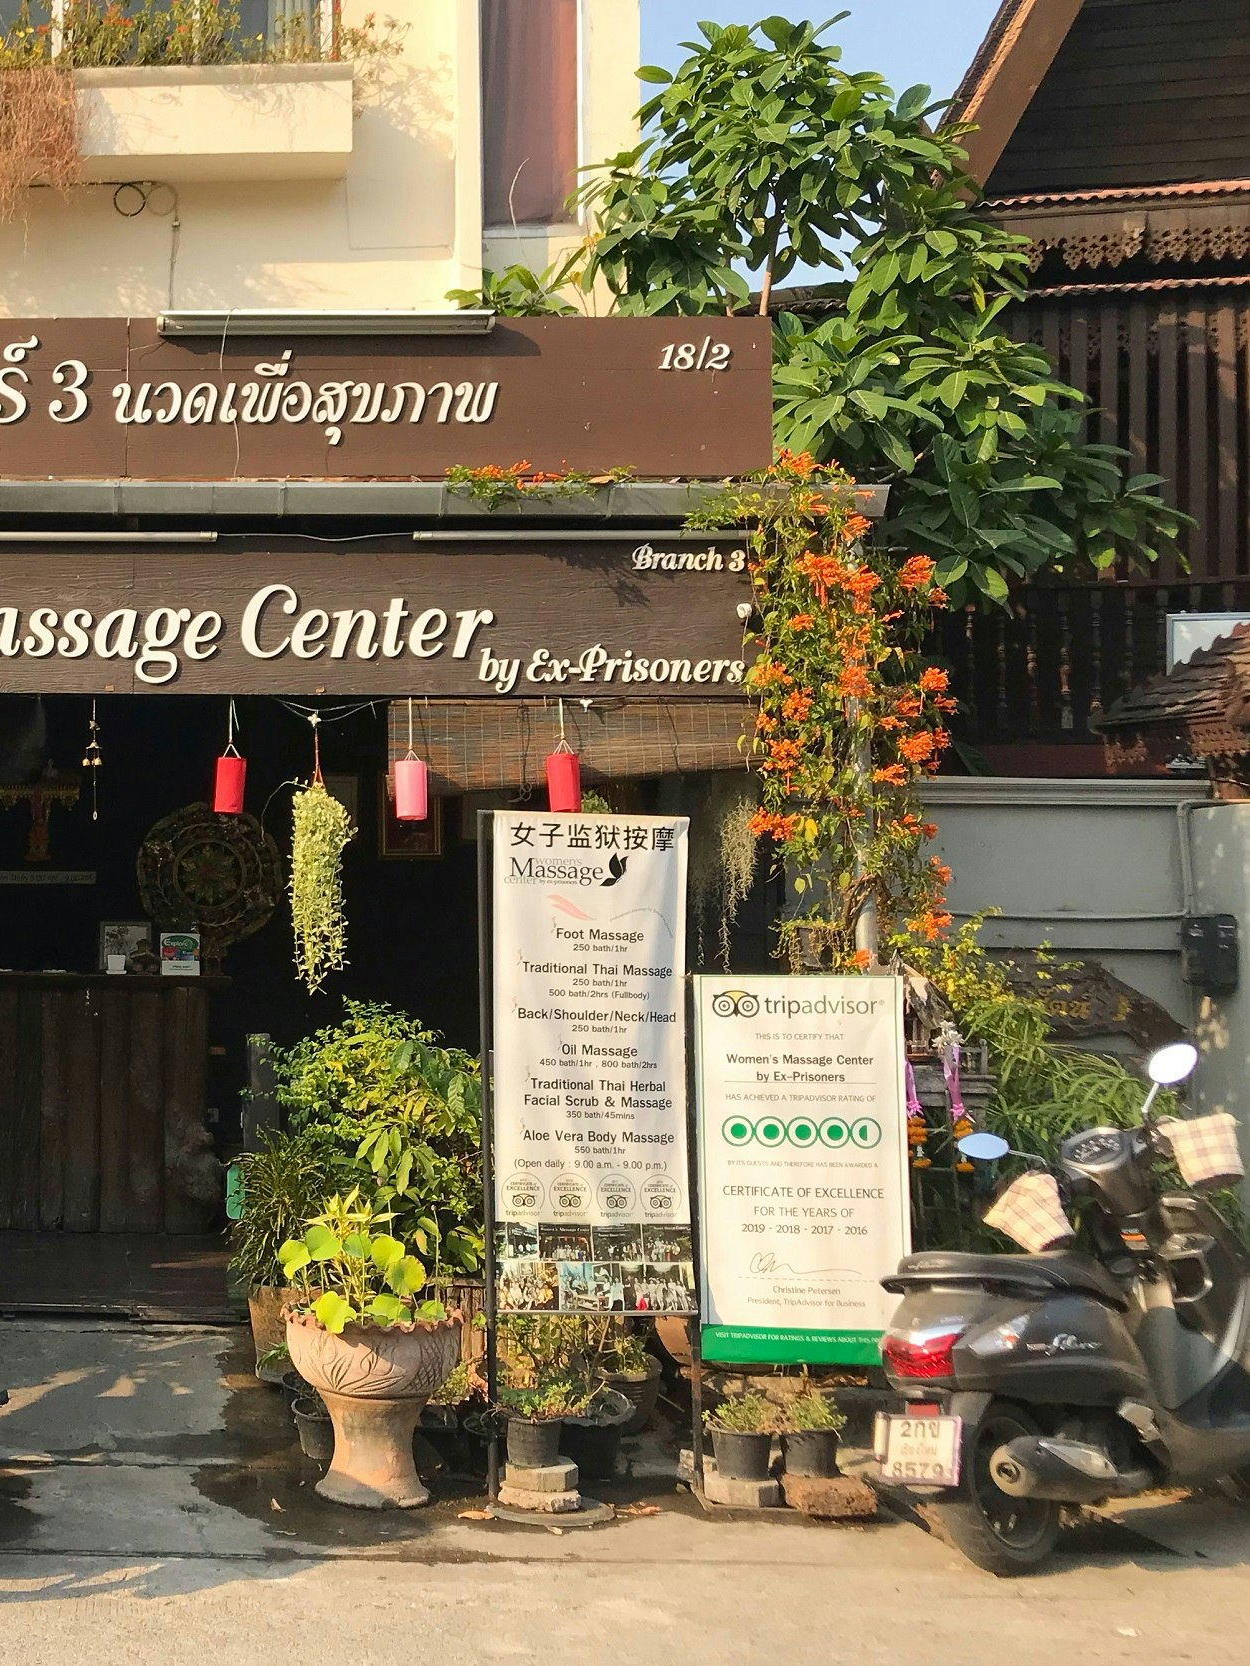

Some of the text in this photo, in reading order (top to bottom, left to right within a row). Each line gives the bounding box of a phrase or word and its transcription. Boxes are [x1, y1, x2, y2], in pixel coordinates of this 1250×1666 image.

[657, 336, 731, 371] 18/2
[50, 360, 90, 424] 3
[112, 349, 499, 446] นวดเพื่อสุขภาพ
[632, 543, 745, 572] Branch 3
[240, 583, 494, 660] Center
[478, 643, 746, 694] by Ex-Prisoners
[510, 821, 675, 852] 女子监狱按摩
[510, 857, 604, 886] Massage
[556, 928, 644, 943] Foot Massage
[593, 944, 628, 953] bath/1hr
[523, 961, 673, 979] Traditional Thai Massage
[572, 978, 627, 987] 250 bath/1hr
[549, 989, 650, 1000] 500 bath/2hrs (Fullbody)
[764, 995, 877, 1019] tripadvisor
[518, 1007, 676, 1023] Back/Shoulder/Neck/Head
[571, 1025, 627, 1034] 250 bath/1hr
[794, 1033, 823, 1041] CERTIFY
[825, 1033, 844, 1041] THAT
[562, 1043, 638, 1058] Oil Massage
[559, 1059, 592, 1068] bath/1hr
[602, 1060, 618, 1068] 800
[621, 1060, 658, 1069] bath/2hrs
[726, 1054, 873, 1067] Women's Massage Center
[756, 1071, 770, 1083] by
[531, 1078, 666, 1092] Traditional Thai Herbal
[524, 1094, 673, 1111] Facial Scrub & Massage
[726, 1093, 741, 1101] HAS
[789, 1094, 836, 1102] TRIPADVISOR
[566, 1111, 635, 1120] 350 bath/45mins
[523, 1130, 675, 1146] Aloe Vera Body Massage
[574, 1146, 626, 1155] 550 bath/1hr
[514, 1158, 667, 1171] (Open daily 9.00 a.m. 9.00 p.m.)
[723, 1185, 884, 1199] CERTIFICATE OF EXCELLENCE
[754, 1206, 855, 1218] FOR THE YEARS OF
[742, 1223, 868, 1235] 2019 2018 2017 2016
[773, 1285, 841, 1296] Christine Petersen
[784, 1298, 822, 1308] TripAdvisor
[824, 1299, 834, 1307] for
[836, 1300, 866, 1308] Business
